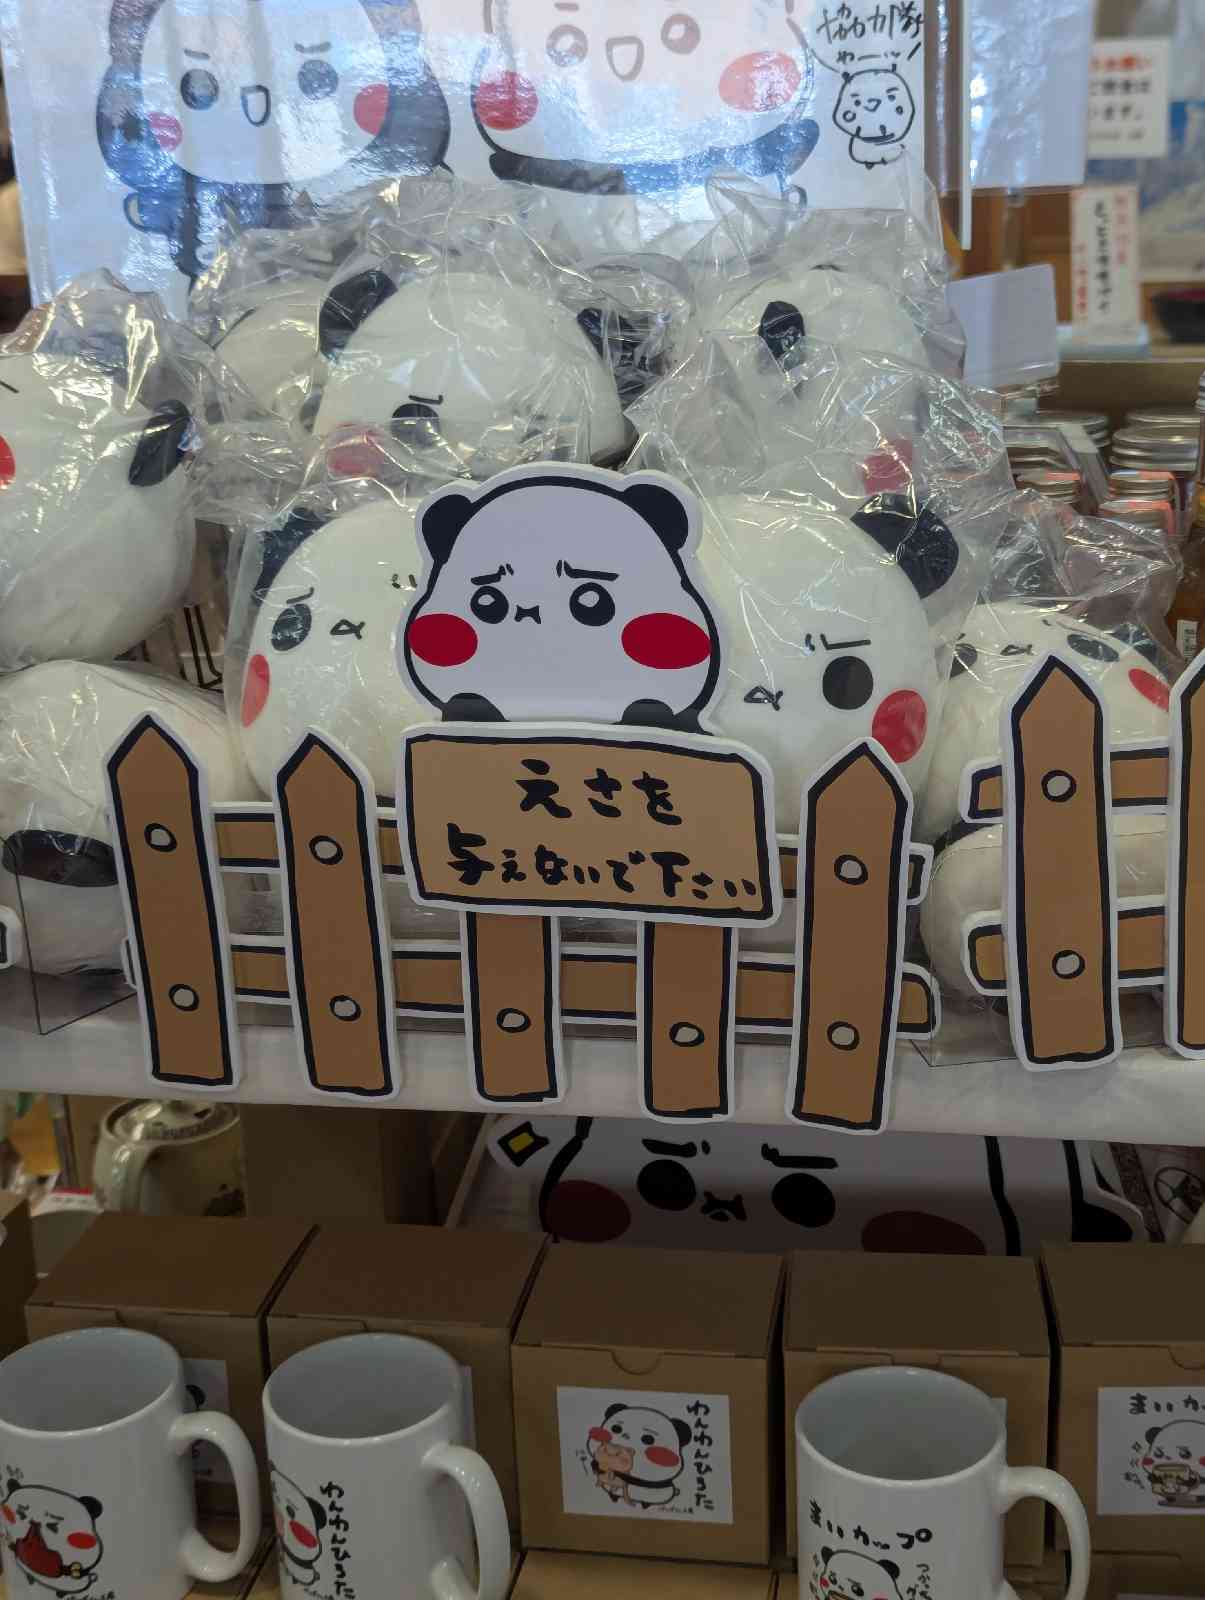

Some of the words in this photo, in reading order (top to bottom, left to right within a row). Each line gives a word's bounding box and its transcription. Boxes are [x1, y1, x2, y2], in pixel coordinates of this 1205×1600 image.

[515, 758, 683, 826] えさを
[446, 822, 757, 901] 与えないで下さい
[1128, 1392, 1205, 1414] まいカ
